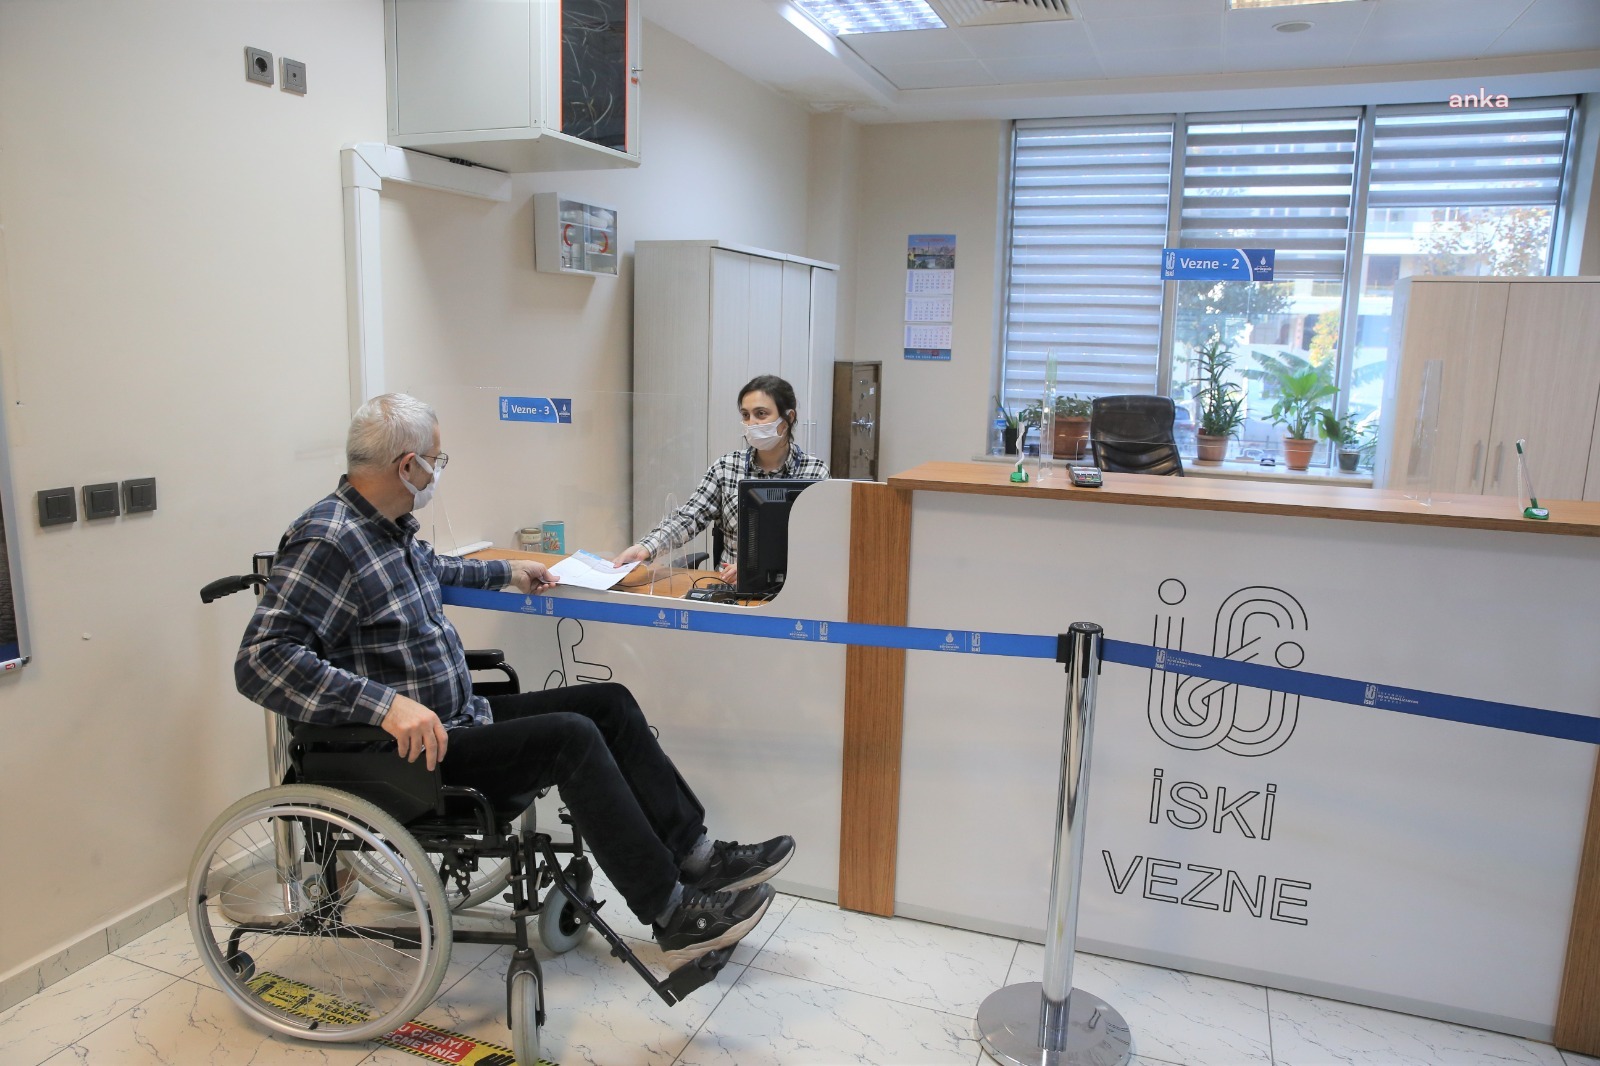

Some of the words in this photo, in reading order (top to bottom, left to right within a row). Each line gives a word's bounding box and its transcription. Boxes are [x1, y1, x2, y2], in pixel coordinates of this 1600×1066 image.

[1180, 257, 1219, 269] Vezne
[1231, 258, 1240, 270] 2
[511, 405, 536, 415] Vezne
[544, 405, 550, 415] 3
[1149, 768, 1278, 841] İSKİ
[1101, 850, 1312, 926] VEZNE
[314, 1002, 370, 1023] MESAFEN
[382, 1031, 461, 1061] EÇMEYİNİZ
[410, 1028, 465, 1050] ÇİZGİYİ
